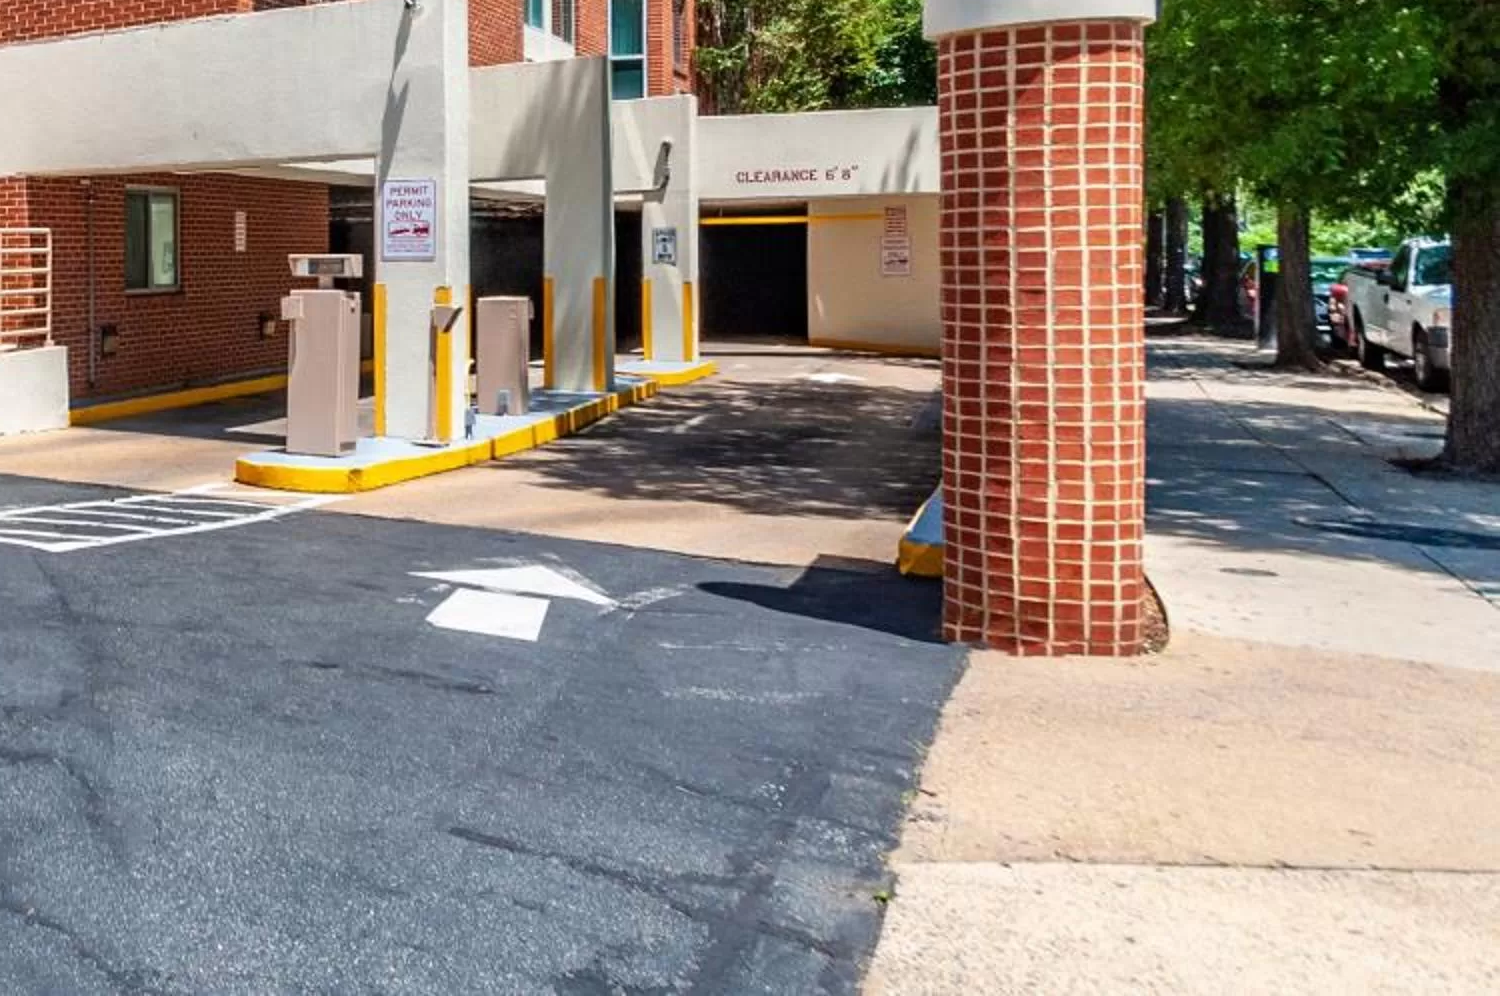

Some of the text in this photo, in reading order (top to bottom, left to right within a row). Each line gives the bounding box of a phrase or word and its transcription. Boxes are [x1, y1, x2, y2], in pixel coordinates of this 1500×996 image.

[736, 169, 817, 183] CLEARANCE
[389, 185, 428, 196] PERMIT
[386, 198, 432, 208] PARKING
[394, 210, 423, 222] ONLY
